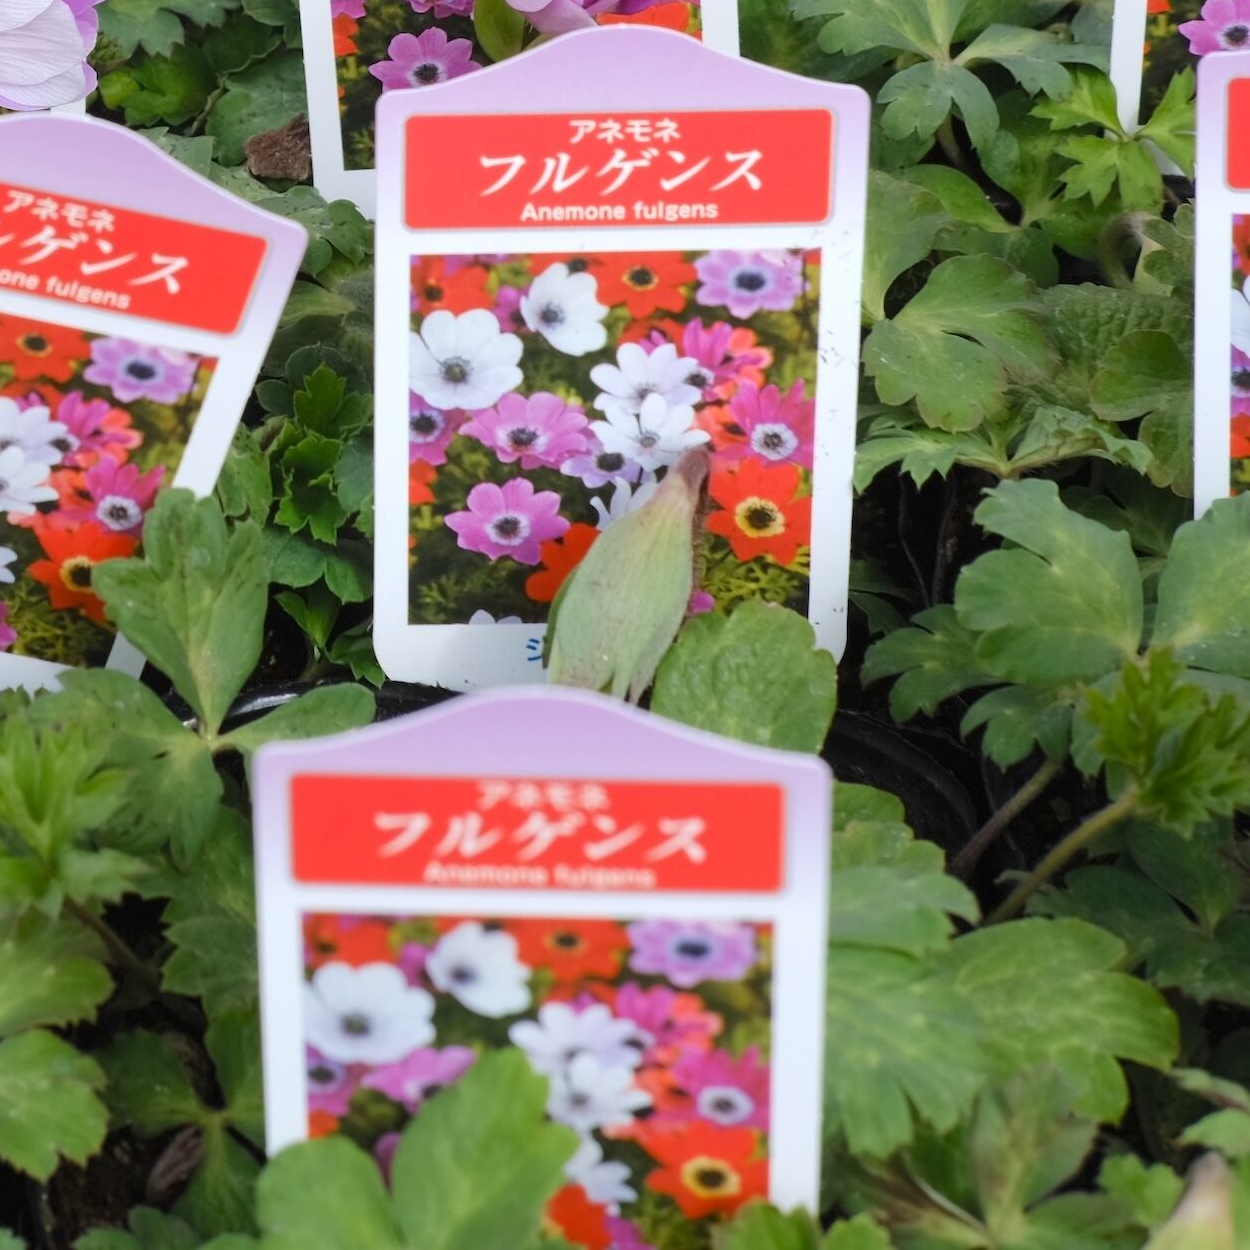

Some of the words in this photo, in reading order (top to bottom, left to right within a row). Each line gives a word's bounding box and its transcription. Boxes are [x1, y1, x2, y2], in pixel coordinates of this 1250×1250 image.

[570, 118, 680, 144] アネモネ
[480, 147, 762, 195] フルゲンス
[4, 190, 114, 233] アネモネ
[521, 203, 626, 221] Anemone
[633, 201, 718, 221] fulgens
[46, 276, 130, 309] fulgens
[480, 784, 607, 810] アネモネ
[375, 810, 706, 863] フルゲンス
